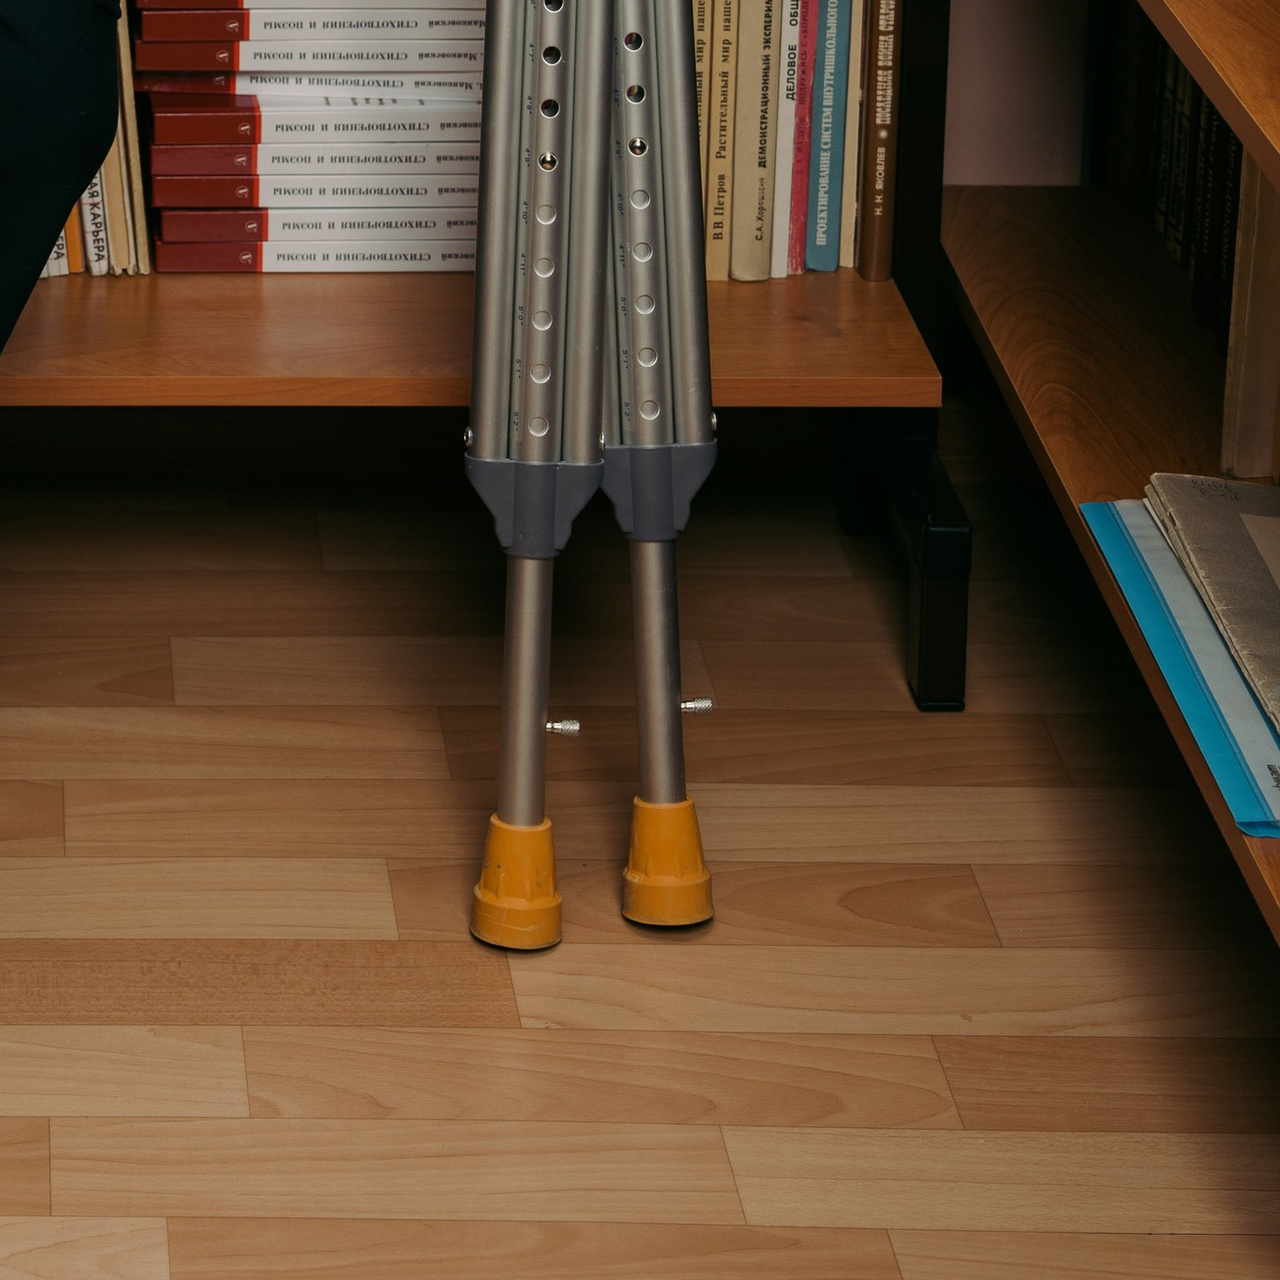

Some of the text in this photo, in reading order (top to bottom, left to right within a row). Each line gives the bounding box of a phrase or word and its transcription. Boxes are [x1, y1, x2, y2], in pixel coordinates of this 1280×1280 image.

[786, 45, 797, 101] ДЕЛОВОЕ
[823, 1, 839, 106] ВНУТРИШКОЛЬНОГО
[716, 71, 730, 160] Растительный
[723, 39, 733, 64] мир
[758, 55, 771, 169] ДЕМОНСТРАЦИОННЫЙ
[822, 107, 833, 148] СИСТЕМ
[816, 150, 832, 246] ПРОЕКТИРОВАНИЕ
[876, 148, 886, 190] ЯКОВЛЕВ
[88, 202, 107, 264] КАРЬЕРА
